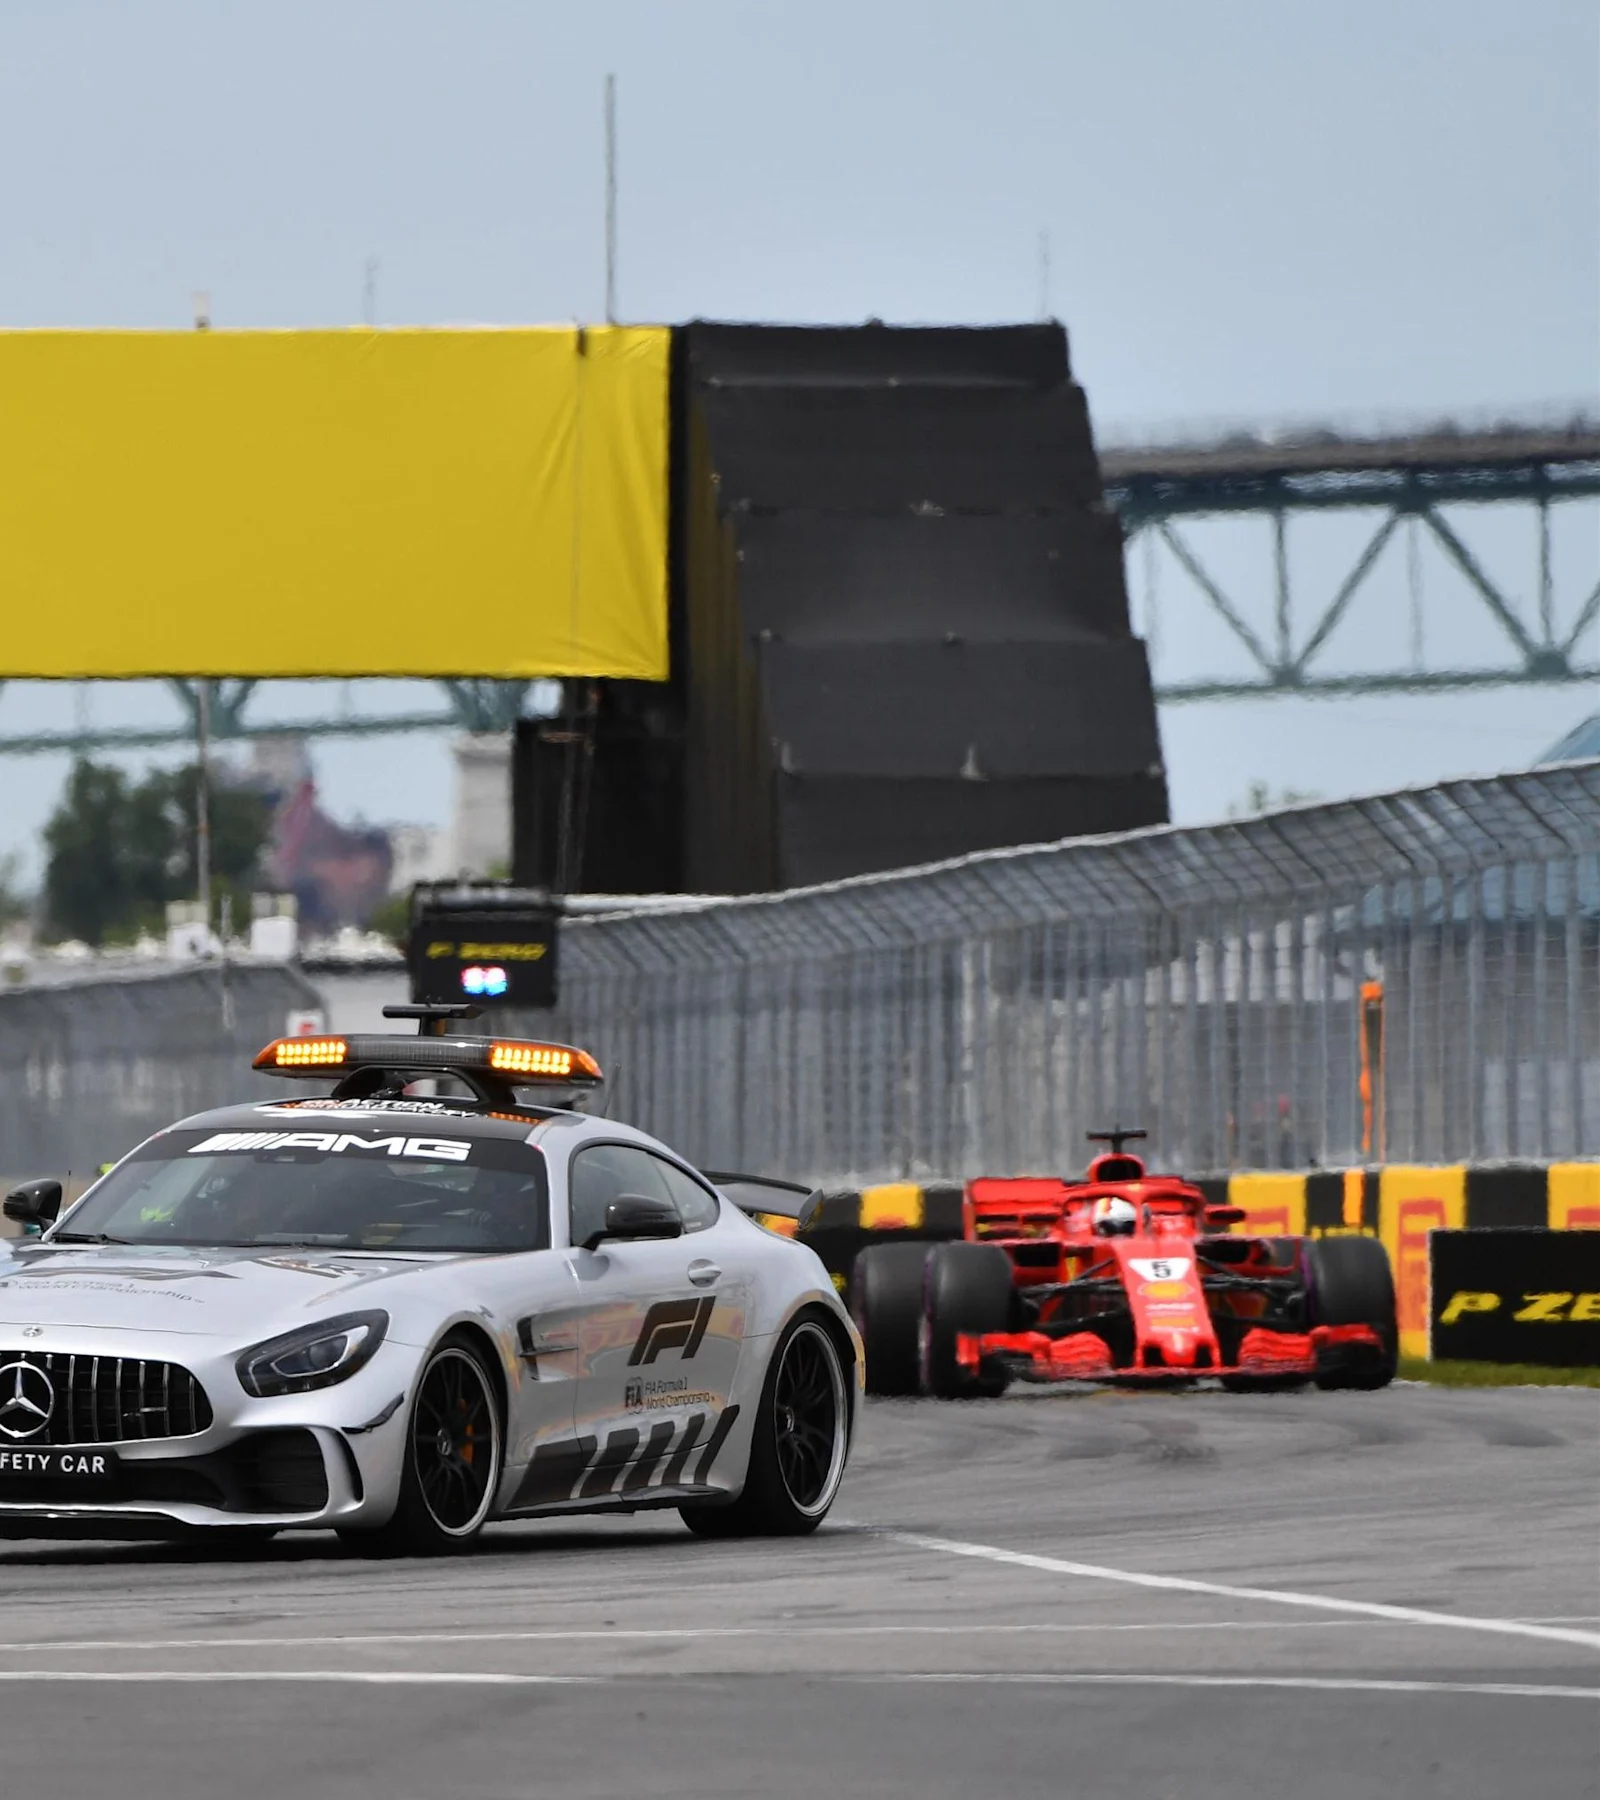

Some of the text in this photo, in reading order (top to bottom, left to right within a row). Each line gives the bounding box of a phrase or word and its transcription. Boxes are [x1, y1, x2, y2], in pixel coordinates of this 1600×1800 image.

[263, 1133, 472, 1161] AMG
[1151, 1261, 1171, 1278] 5
[1439, 1291, 1502, 1325] P
[627, 1296, 716, 1366] F1
[60, 1454, 105, 1474] CAR
